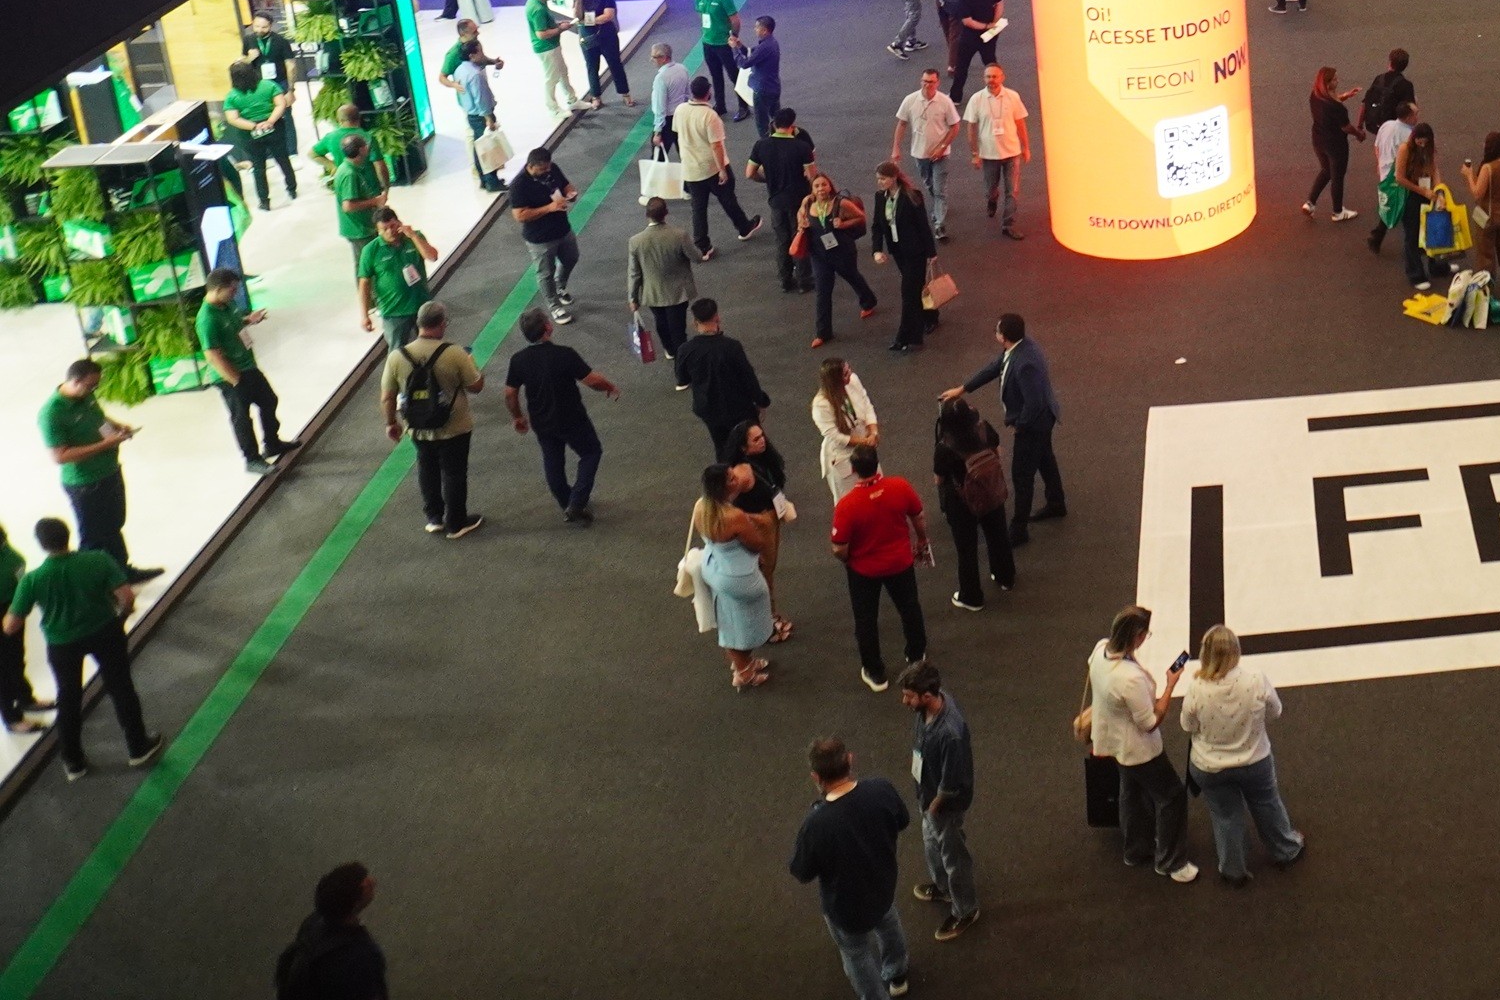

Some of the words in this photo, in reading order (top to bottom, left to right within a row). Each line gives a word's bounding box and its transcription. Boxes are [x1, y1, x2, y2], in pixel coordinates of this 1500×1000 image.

[1086, 6, 1111, 22] Oi!
[1088, 28, 1156, 44] ACESSE
[1160, 20, 1210, 42] TUDO
[1212, 9, 1232, 29] NO
[1126, 71, 1195, 91] FEICON
[1088, 215, 1115, 229] SEM
[1208, 193, 1243, 218] DIRETO
